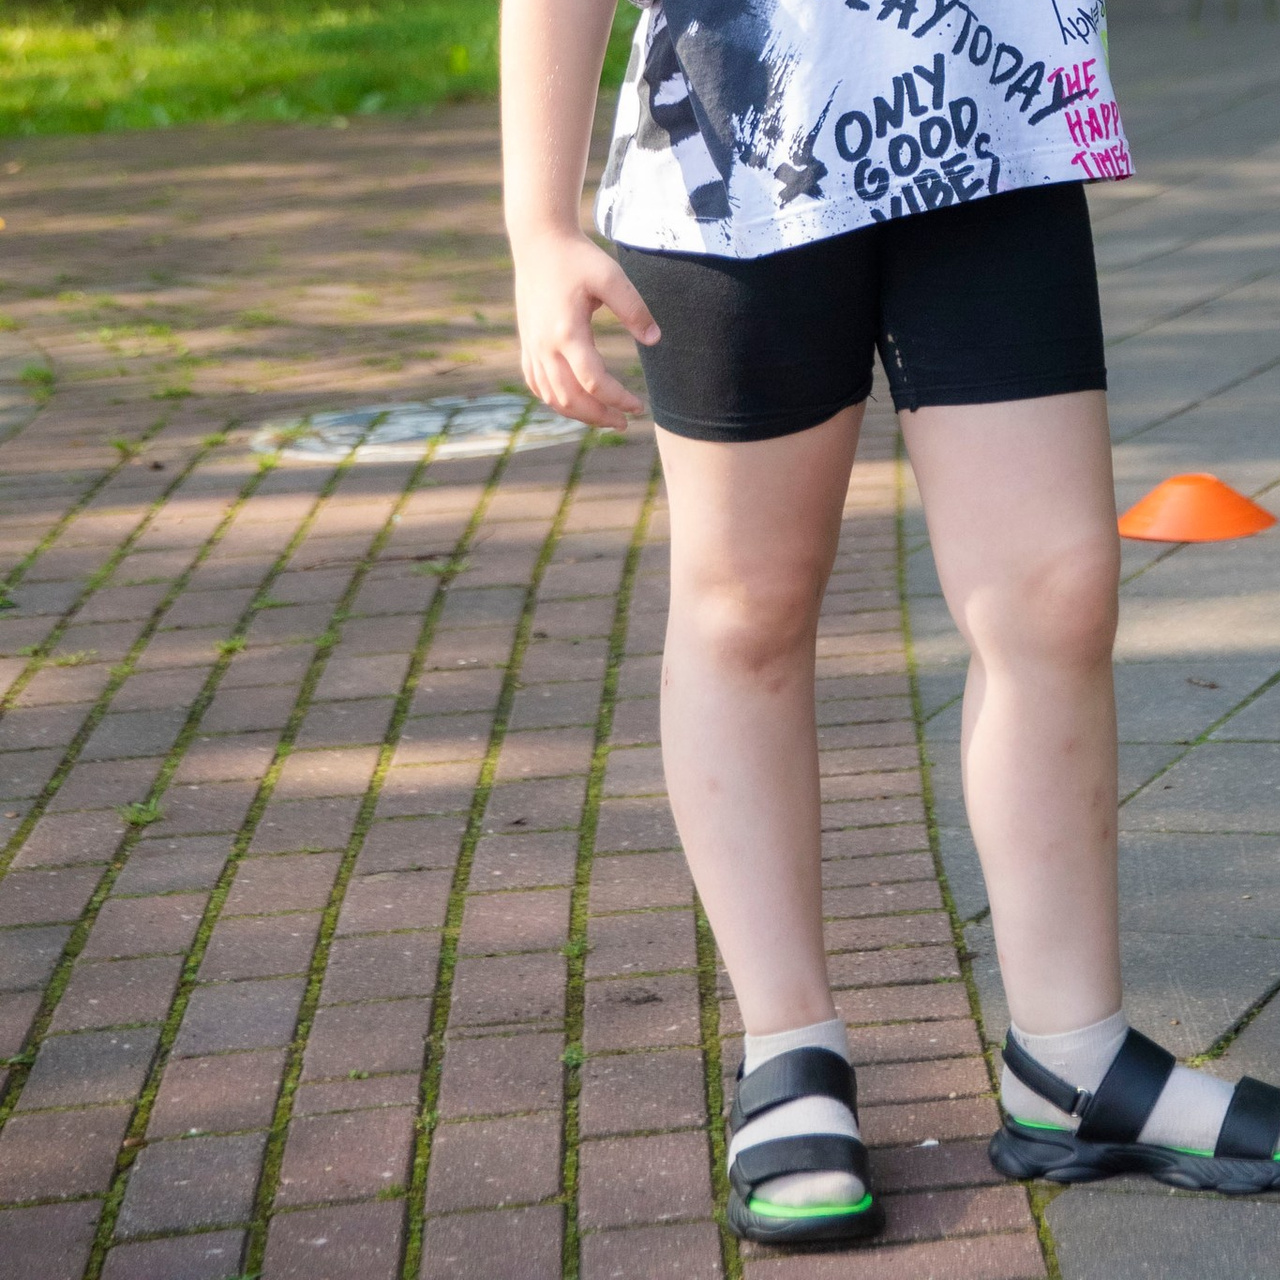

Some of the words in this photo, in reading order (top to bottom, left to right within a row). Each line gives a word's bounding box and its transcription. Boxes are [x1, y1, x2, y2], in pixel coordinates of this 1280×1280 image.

[834, 53, 945, 162] ONLY
[1047, 58, 1099, 108] THE
[854, 96, 978, 201] GOOD
[1064, 100, 1120, 149] HAPP
